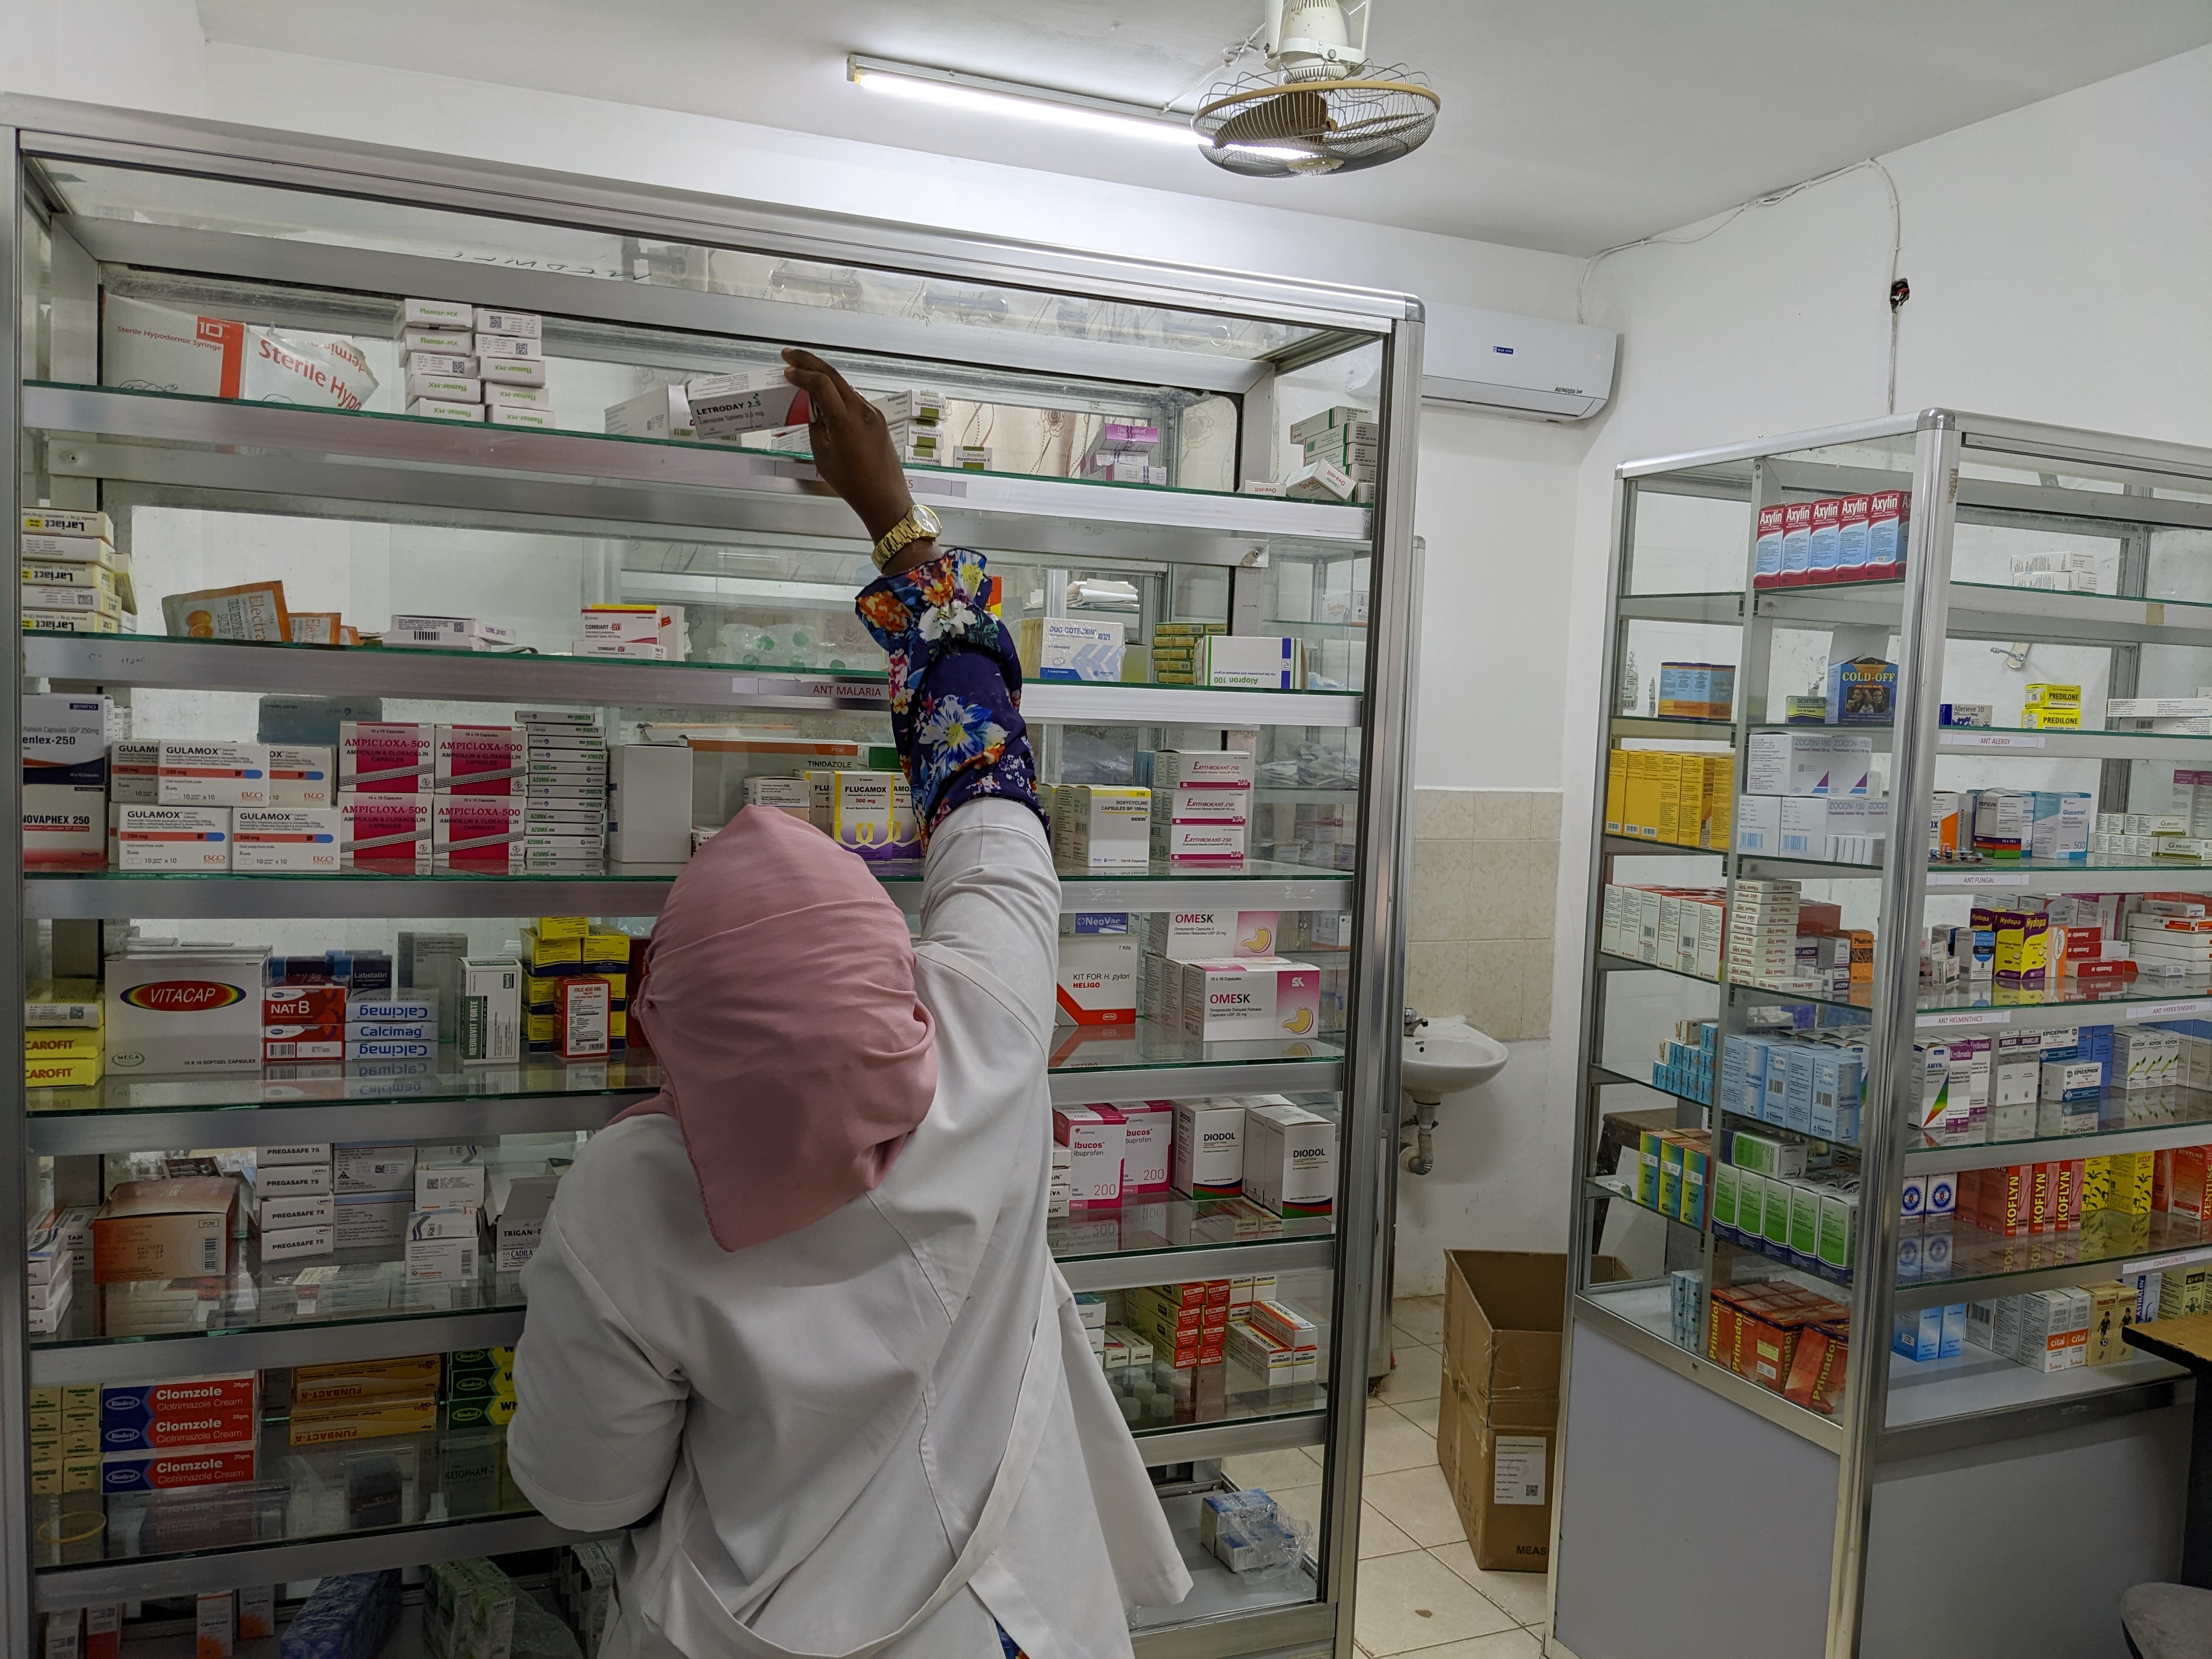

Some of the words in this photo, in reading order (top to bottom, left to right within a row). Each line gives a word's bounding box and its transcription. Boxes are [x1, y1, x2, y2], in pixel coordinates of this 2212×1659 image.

[199, 321, 222, 337] 10
[117, 326, 142, 335] Sterile
[144, 330, 191, 344] Hypodermic
[193, 340, 222, 351] Syringe
[258, 339, 326, 387] Sterile
[697, 403, 744, 415] LETRODAY
[1842, 499, 1867, 516] Axylin
[1872, 494, 1898, 512] Axylin
[1786, 508, 1809, 522] Axylin
[1814, 504, 1838, 519] Axylin
[1760, 512, 1782, 526] Axylin
[45, 520, 84, 531] Lariact
[33, 571, 73, 582] Lariact
[36, 620, 75, 631] Lariact
[1843, 672, 1895, 682] COLD-OFF
[813, 685, 833, 695] ANT
[837, 686, 881, 696] MALARIA
[2043, 716, 2078, 725] PREDILONE
[345, 740, 430, 748] AMPICLOXA-500
[440, 743, 522, 752] AMPICLOXA-500
[167, 747, 218, 755] GULAMOX
[1829, 802, 1865, 810] ZOCON-150
[72, 816, 90, 825] 250
[240, 812, 290, 821] GULAMOX
[1085, 917, 1120, 926] NeoVac
[1175, 914, 1214, 924] OMESK
[1972, 914, 1989, 922] Hydopa
[2026, 918, 2046, 929] Hydopa
[1112, 972, 1130, 981] pylori
[150, 988, 216, 1004] VITACAP
[1210, 993, 1250, 1005] OMESK
[270, 1004, 296, 1014] NAT
[298, 1001, 309, 1014] B
[359, 1005, 428, 1017] Calcimag
[360, 1026, 422, 1038] Calcimag
[469, 1023, 477, 1056] NEUROVIT
[359, 1043, 427, 1056] Calcimag
[1204, 1132, 1236, 1141] DIODOL
[1074, 1141, 1103, 1150] Ibucos
[1074, 1149, 1104, 1158] Ibuprofen
[1293, 1148, 1326, 1158] DIODOL
[2178, 1149, 2203, 1159] ZENTUSS
[1143, 1169, 1164, 1181] 200
[1094, 1184, 1116, 1196] 200
[2057, 1171, 2070, 1221] KOFLYN
[2006, 1176, 2019, 1227] KOFLYN
[2033, 1172, 2046, 1223] KOFLYN
[2136, 1279, 2145, 1323] ASTHALIN
[1709, 1301, 1719, 1359] Prinadol
[1733, 1312, 1743, 1372] Prinadol
[2051, 1336, 2065, 1346] cital
[2072, 1333, 2085, 1342] cital
[1813, 1339, 1836, 1401] Prinadol
[156, 1387, 222, 1401] Clomzole
[301, 1387, 362, 1400] FUNBACT-A
[157, 1400, 211, 1411] Clotrimazole
[214, 1398, 242, 1407] Cream
[156, 1419, 222, 1432] Clomzole
[157, 1432, 211, 1443] Clotrimazole
[213, 1430, 242, 1438] Cream
[295, 1430, 357, 1442] FUNBACT-A
[157, 1459, 223, 1473] Clomzole
[158, 1472, 212, 1484] Clotrimazole
[215, 1470, 244, 1479] Cream
